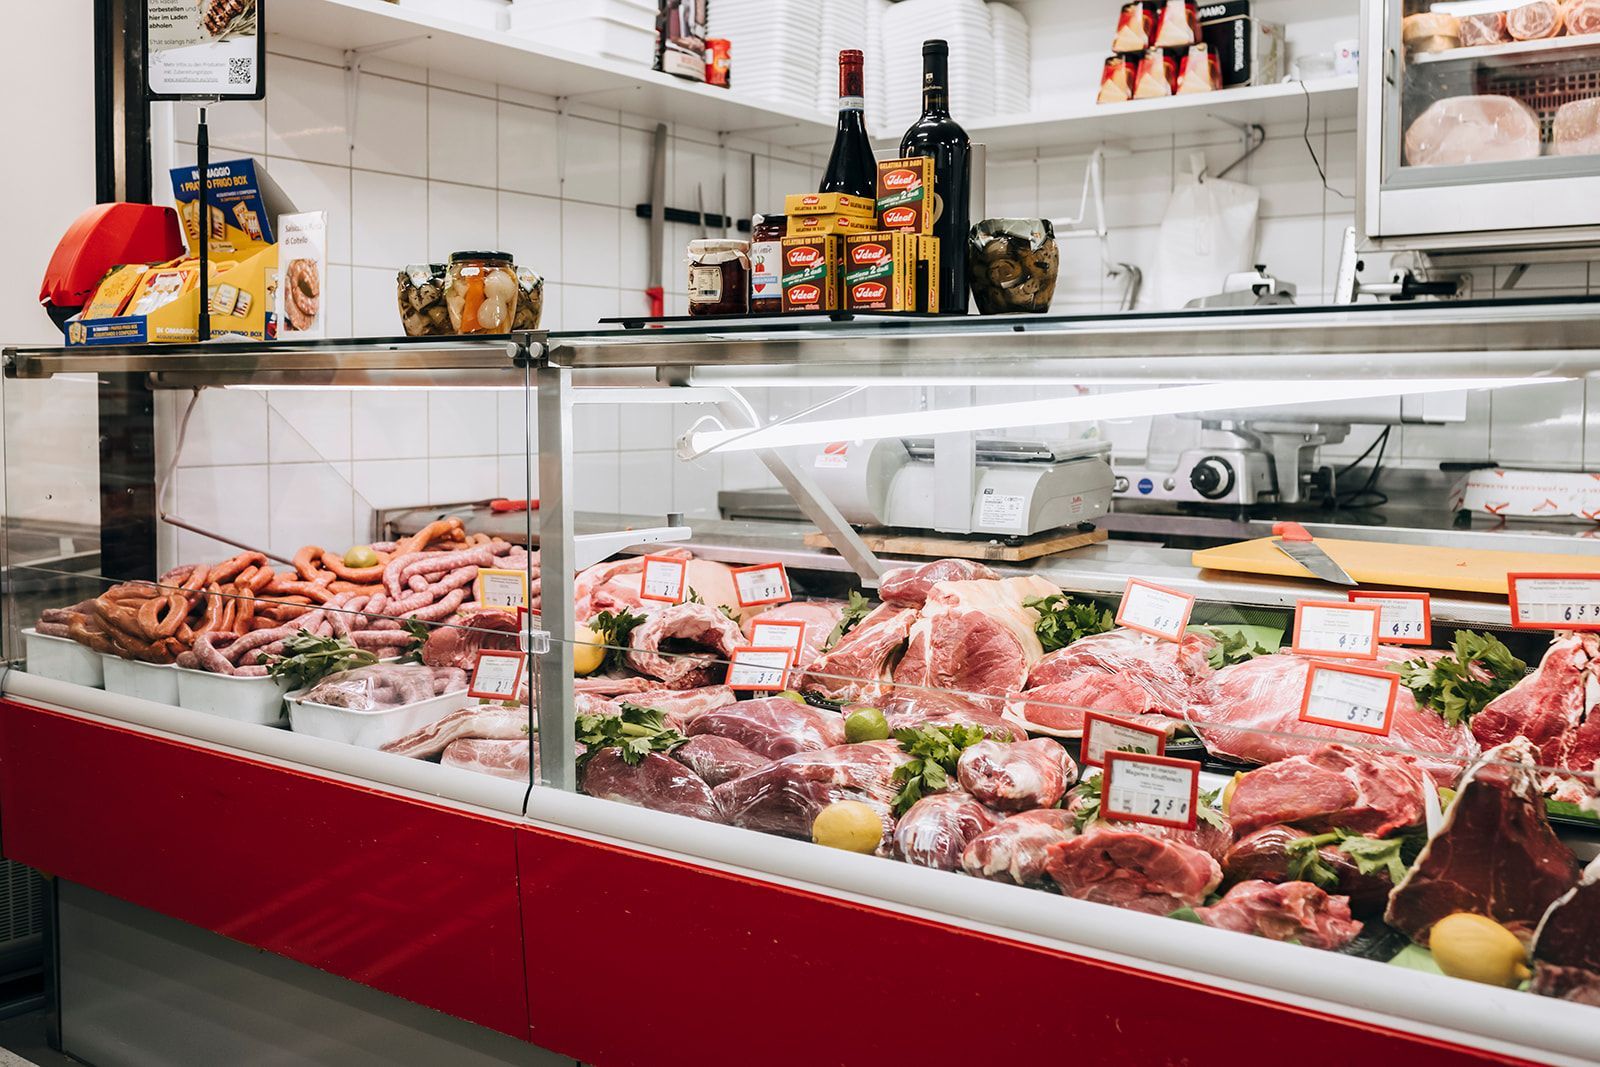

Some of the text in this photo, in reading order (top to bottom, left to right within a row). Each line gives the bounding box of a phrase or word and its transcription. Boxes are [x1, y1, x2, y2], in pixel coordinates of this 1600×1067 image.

[207, 166, 230, 178] MAGGIO
[213, 178, 232, 188] FRIGO
[234, 175, 248, 185] BOX
[887, 174, 914, 185] Ideal
[901, 191, 906, 200] 2
[886, 212, 913, 222] Ideal
[790, 252, 817, 262] Ideal
[855, 249, 883, 260] Ideal
[804, 268, 809, 277] 2
[870, 265, 876, 274] 2
[792, 289, 817, 300] Ideal
[856, 288, 883, 298] Ideal
